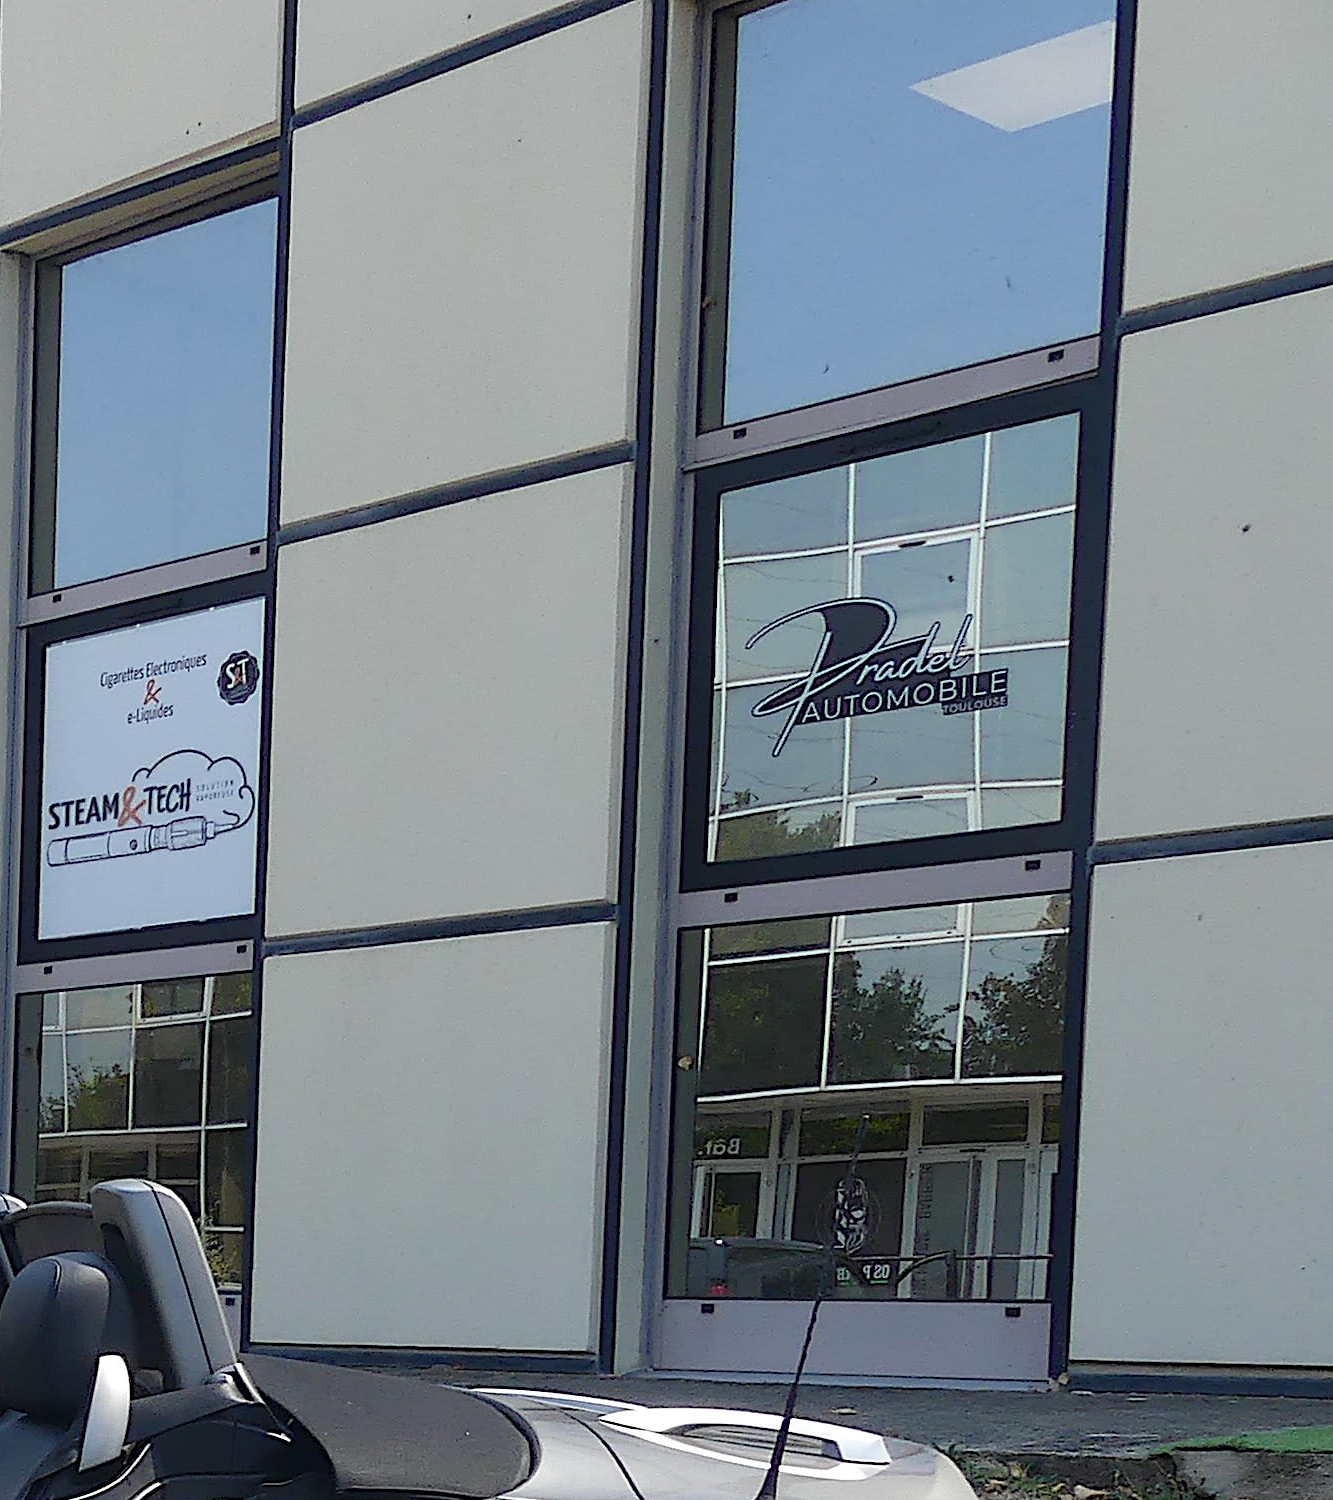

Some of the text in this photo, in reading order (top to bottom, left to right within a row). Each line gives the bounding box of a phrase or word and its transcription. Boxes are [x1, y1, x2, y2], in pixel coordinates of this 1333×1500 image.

[100, 653, 207, 688] Cigarettes Electroniques
[745, 596, 974, 757] Pradel
[127, 703, 174, 725] e-Liquides
[802, 671, 1008, 723] AUTOMOBILE
[943, 696, 1007, 714] TOULOUSE
